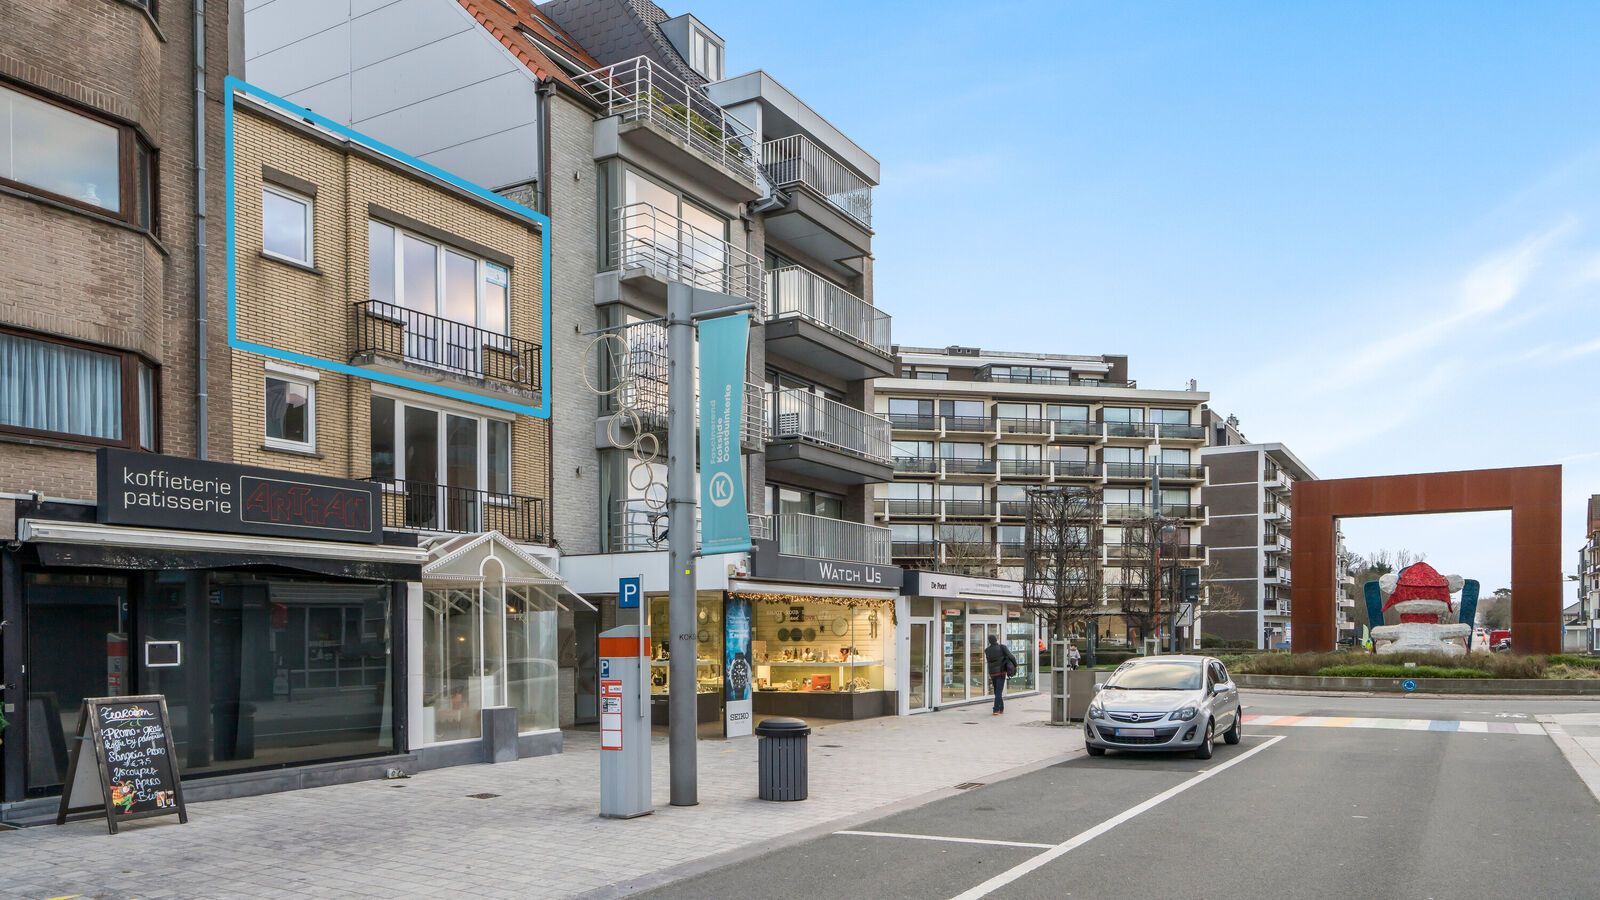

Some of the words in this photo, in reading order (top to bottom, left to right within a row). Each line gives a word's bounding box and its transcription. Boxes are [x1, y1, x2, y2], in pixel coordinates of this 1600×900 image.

[724, 384, 732, 462] Oostduinkerke
[124, 466, 232, 496] koffieterie
[716, 480, 726, 498] K
[124, 490, 232, 514] patisserie
[624, 583, 637, 603] P
[601, 660, 609, 674] P
[729, 712, 749, 721] SEIKO
